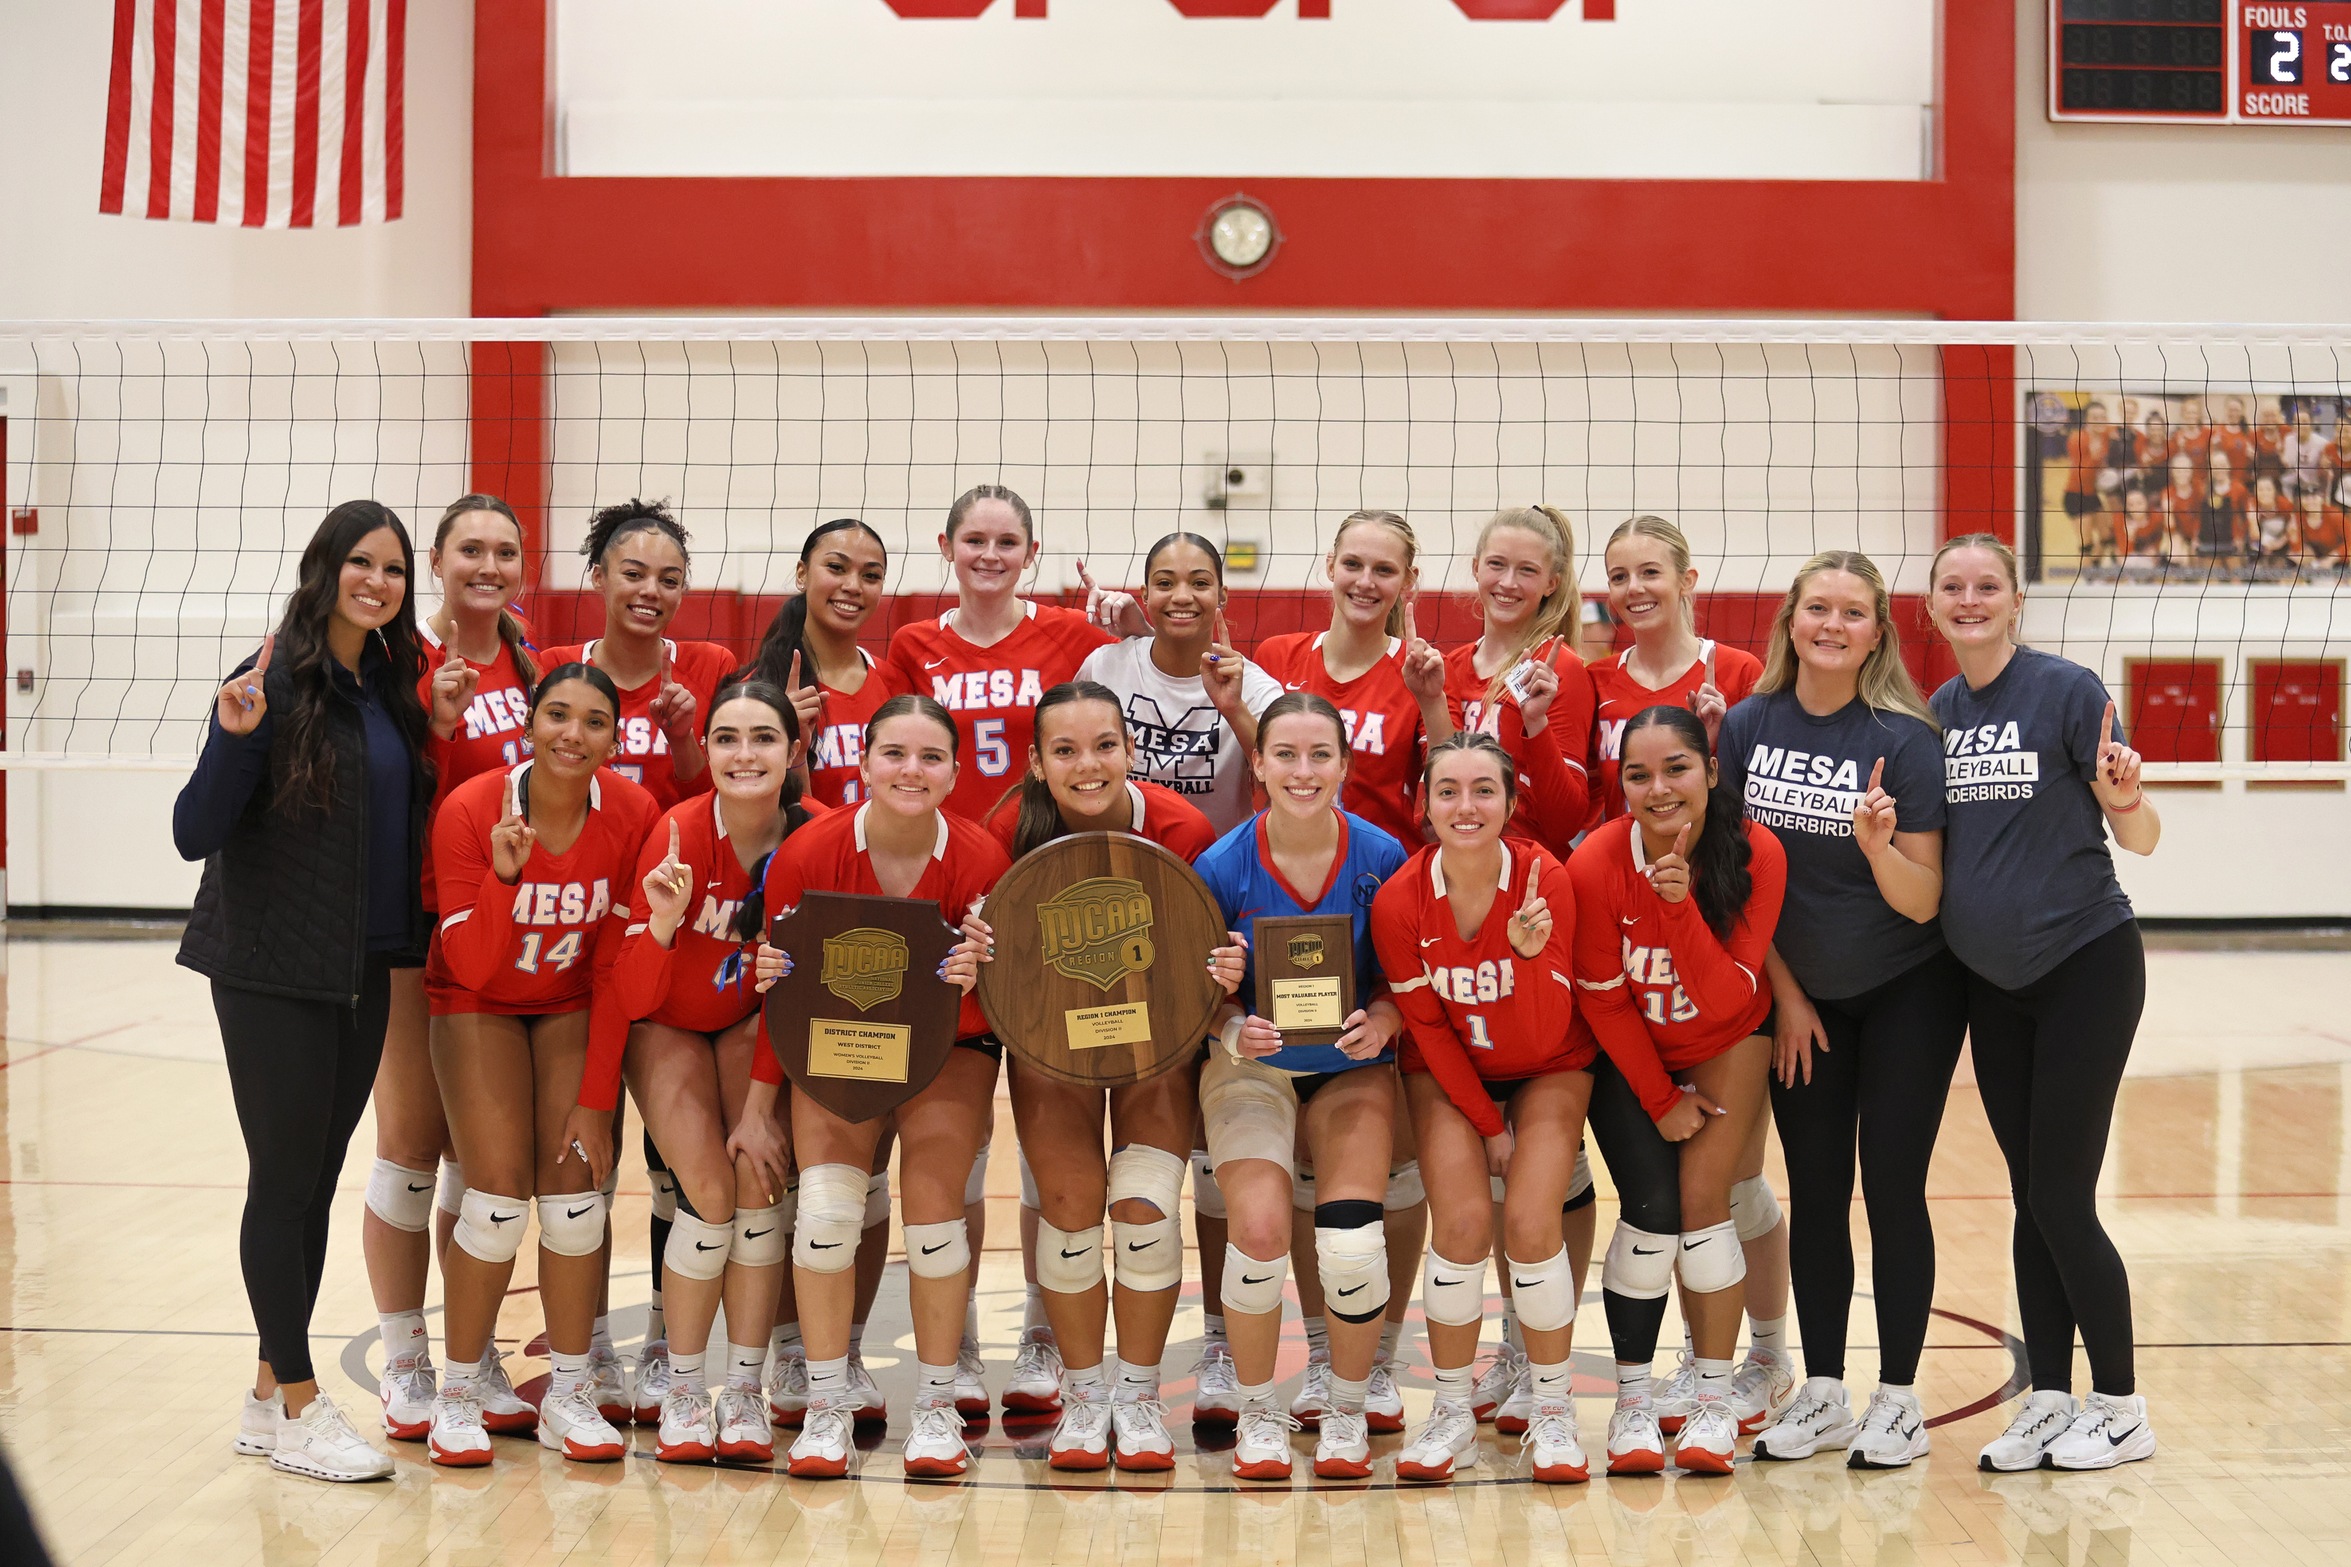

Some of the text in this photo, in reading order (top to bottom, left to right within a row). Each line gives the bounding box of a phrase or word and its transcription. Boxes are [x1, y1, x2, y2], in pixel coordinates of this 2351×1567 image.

[2244, 7, 2307, 28] FOULS
[2322, 24, 2351, 41] T.O.
[2270, 31, 2299, 82] 2
[2331, 43, 2351, 81] 2
[2245, 92, 2309, 115] SCORE
[931, 668, 1044, 710] MESA
[463, 686, 530, 740] MES
[813, 724, 868, 770] ME
[973, 717, 1011, 777] 5
[1126, 721, 1213, 753] MESA
[1943, 720, 2021, 757] MESA
[1747, 744, 1858, 790] MESA
[1945, 783, 2034, 807] NDERBIRDS
[512, 878, 610, 925] MESA
[1043, 896, 1148, 957] NJCAA
[515, 931, 583, 975] 14
[825, 942, 905, 980] NJCAA
[1068, 950, 1115, 966] REGION
[1132, 944, 1142, 962] 1
[1104, 1008, 1136, 1018] CHAMPION
[1643, 984, 1699, 1026] 15
[824, 1028, 896, 1040] DISTRICT CHAMPION
[1466, 1014, 1494, 1051] 1
